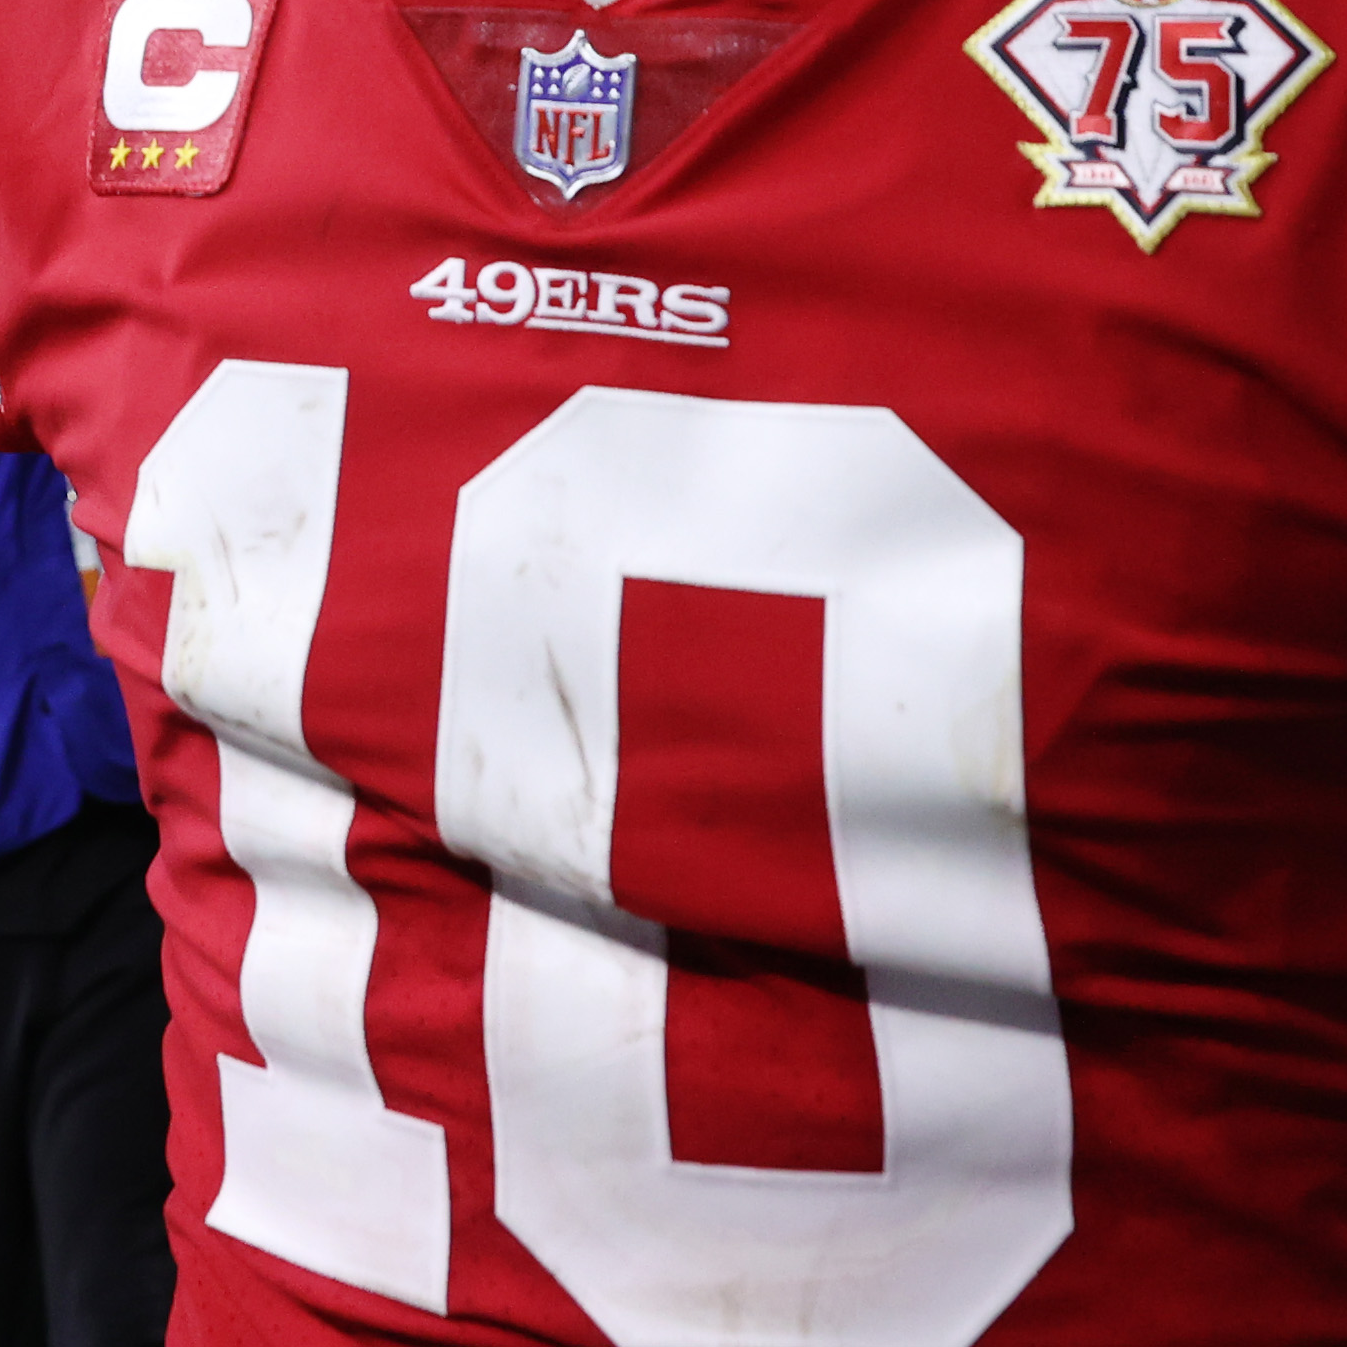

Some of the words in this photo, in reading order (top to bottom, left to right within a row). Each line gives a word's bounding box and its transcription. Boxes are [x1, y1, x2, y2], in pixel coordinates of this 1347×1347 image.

[533, 107, 612, 166] NFL
[1054, 13, 1247, 155] 75
[409, 257, 731, 336] 49ERS
[124, 358, 1074, 1347] 10
